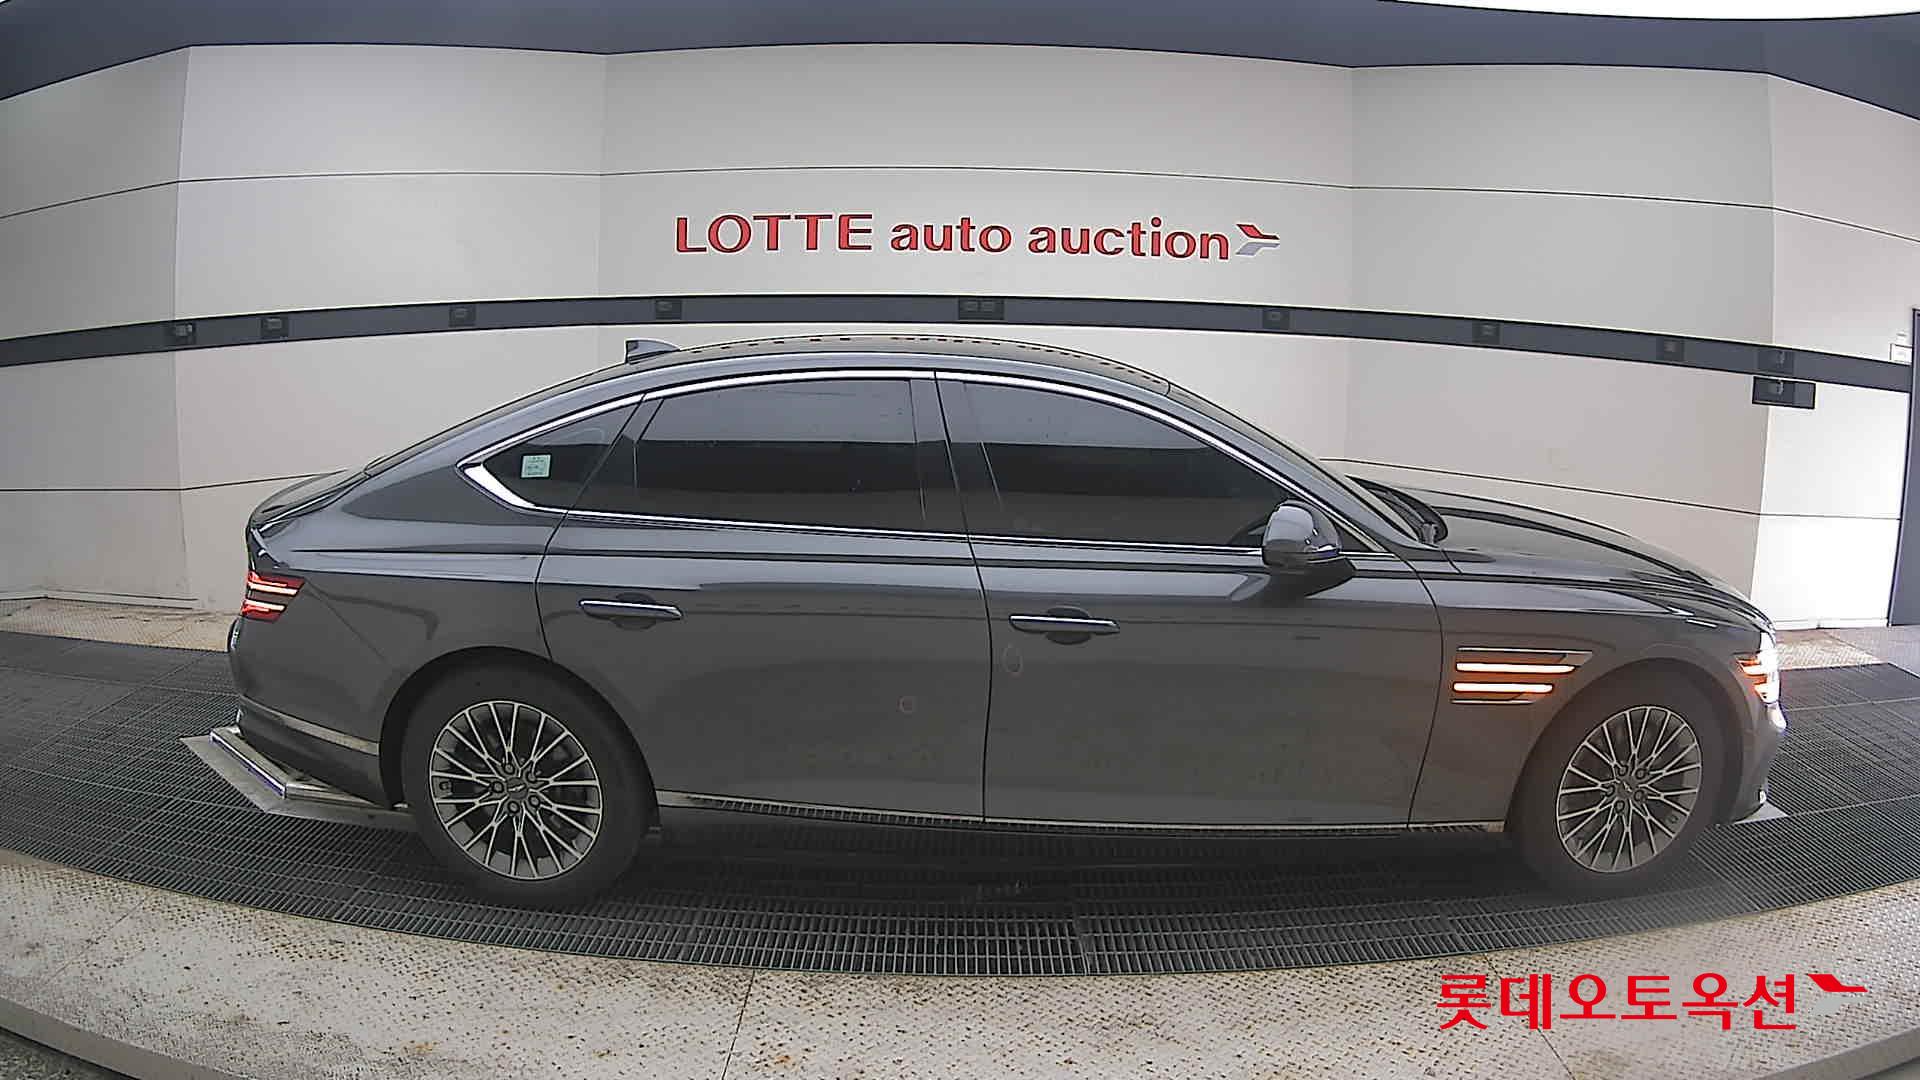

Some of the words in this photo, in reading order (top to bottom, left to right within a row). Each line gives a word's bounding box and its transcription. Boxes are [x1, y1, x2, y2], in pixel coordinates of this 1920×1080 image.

[676, 213, 873, 253] LOTTE
[890, 216, 1013, 253] auto
[1029, 217, 1230, 260] auction
